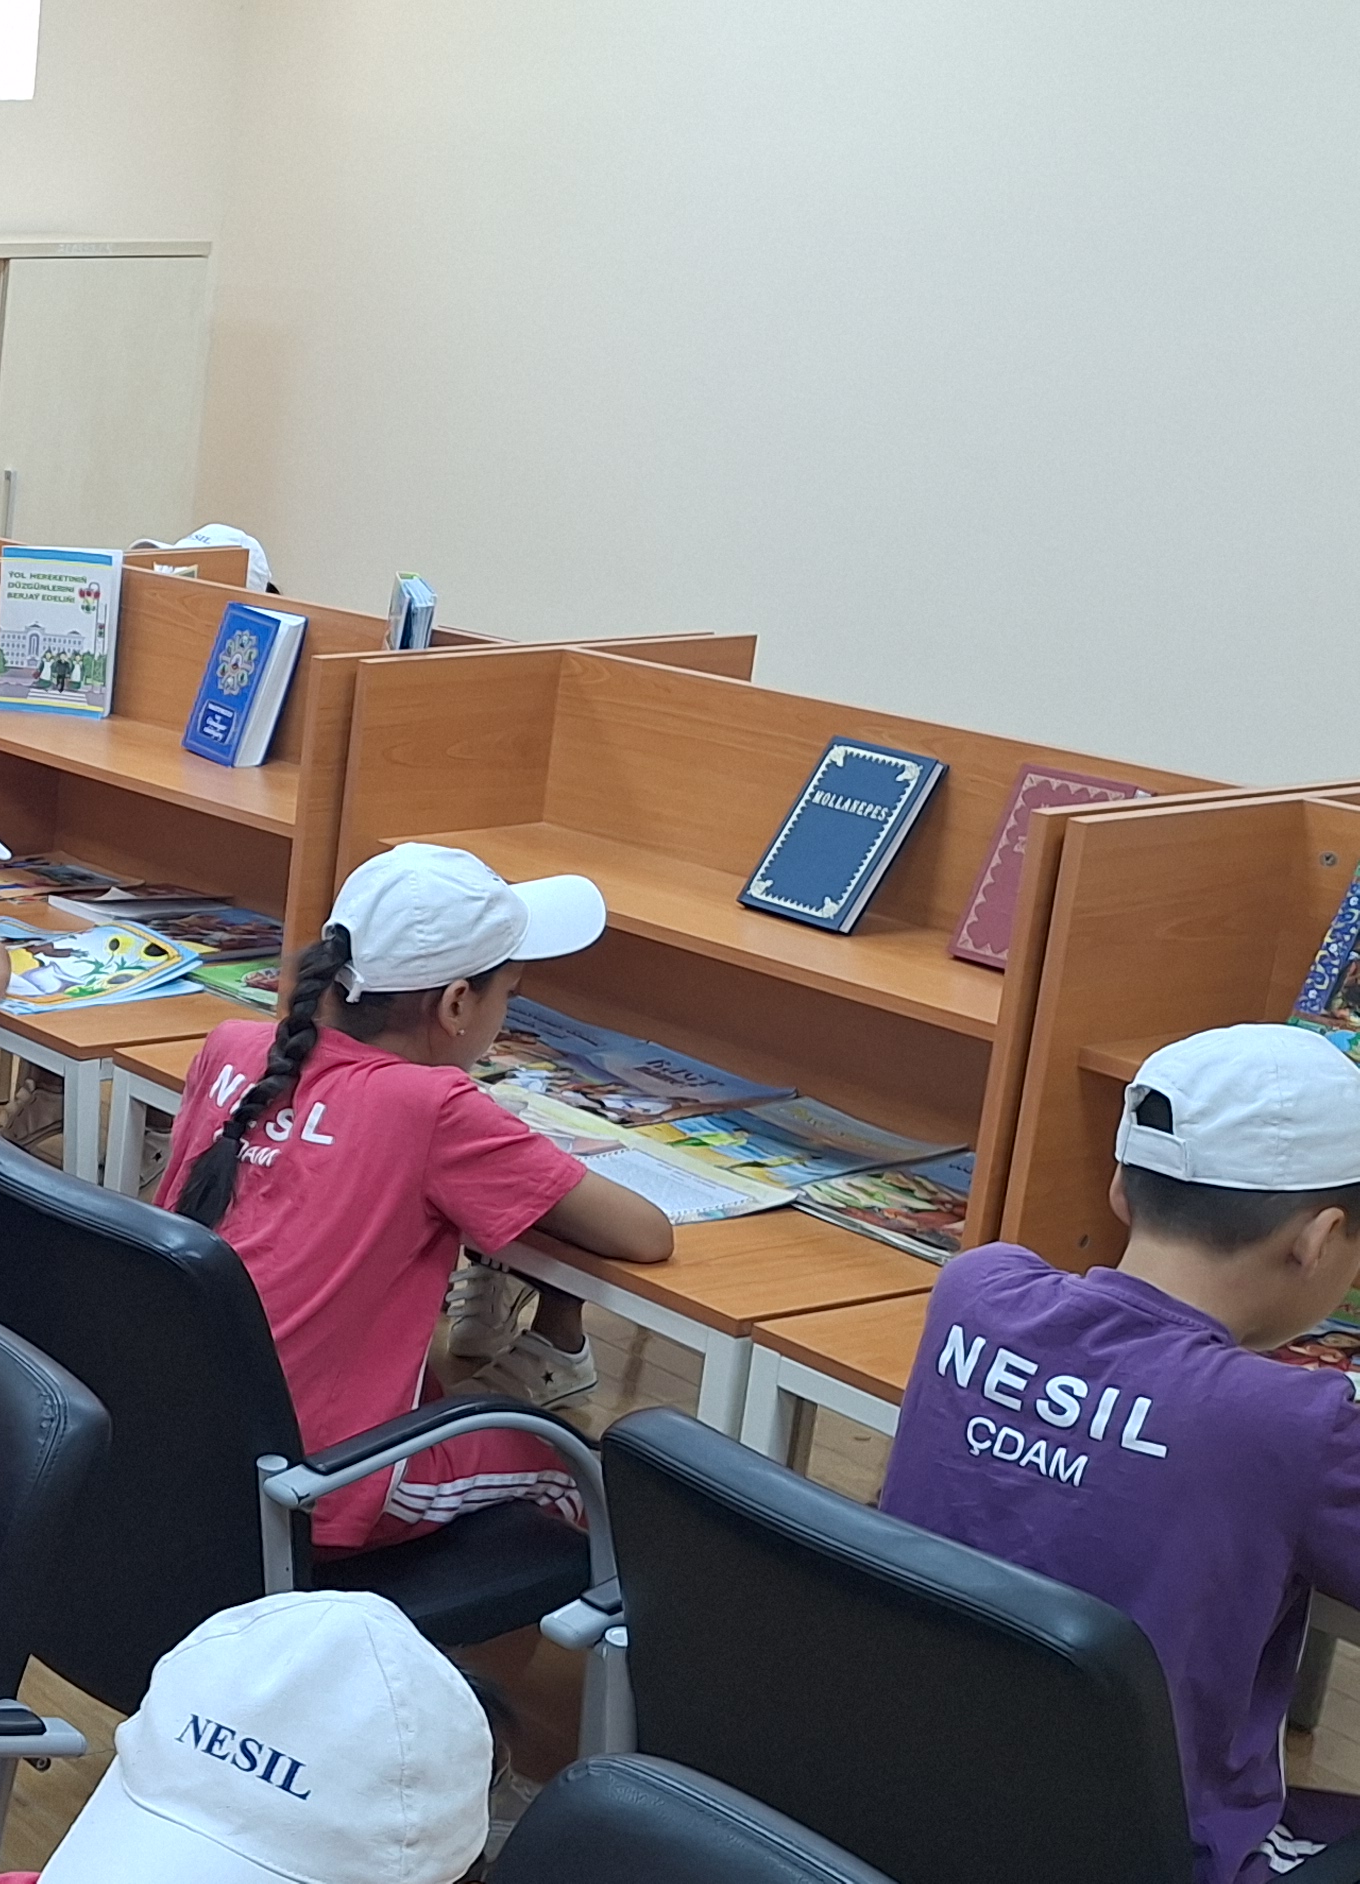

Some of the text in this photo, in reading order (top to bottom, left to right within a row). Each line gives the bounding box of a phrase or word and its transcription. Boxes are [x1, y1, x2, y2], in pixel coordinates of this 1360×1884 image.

[811, 789, 890, 821] MOLLANEPES
[936, 1323, 1168, 1459] NESIL
[966, 1415, 1088, 1487] ÇDAM
[175, 1713, 312, 1801] NESIL
